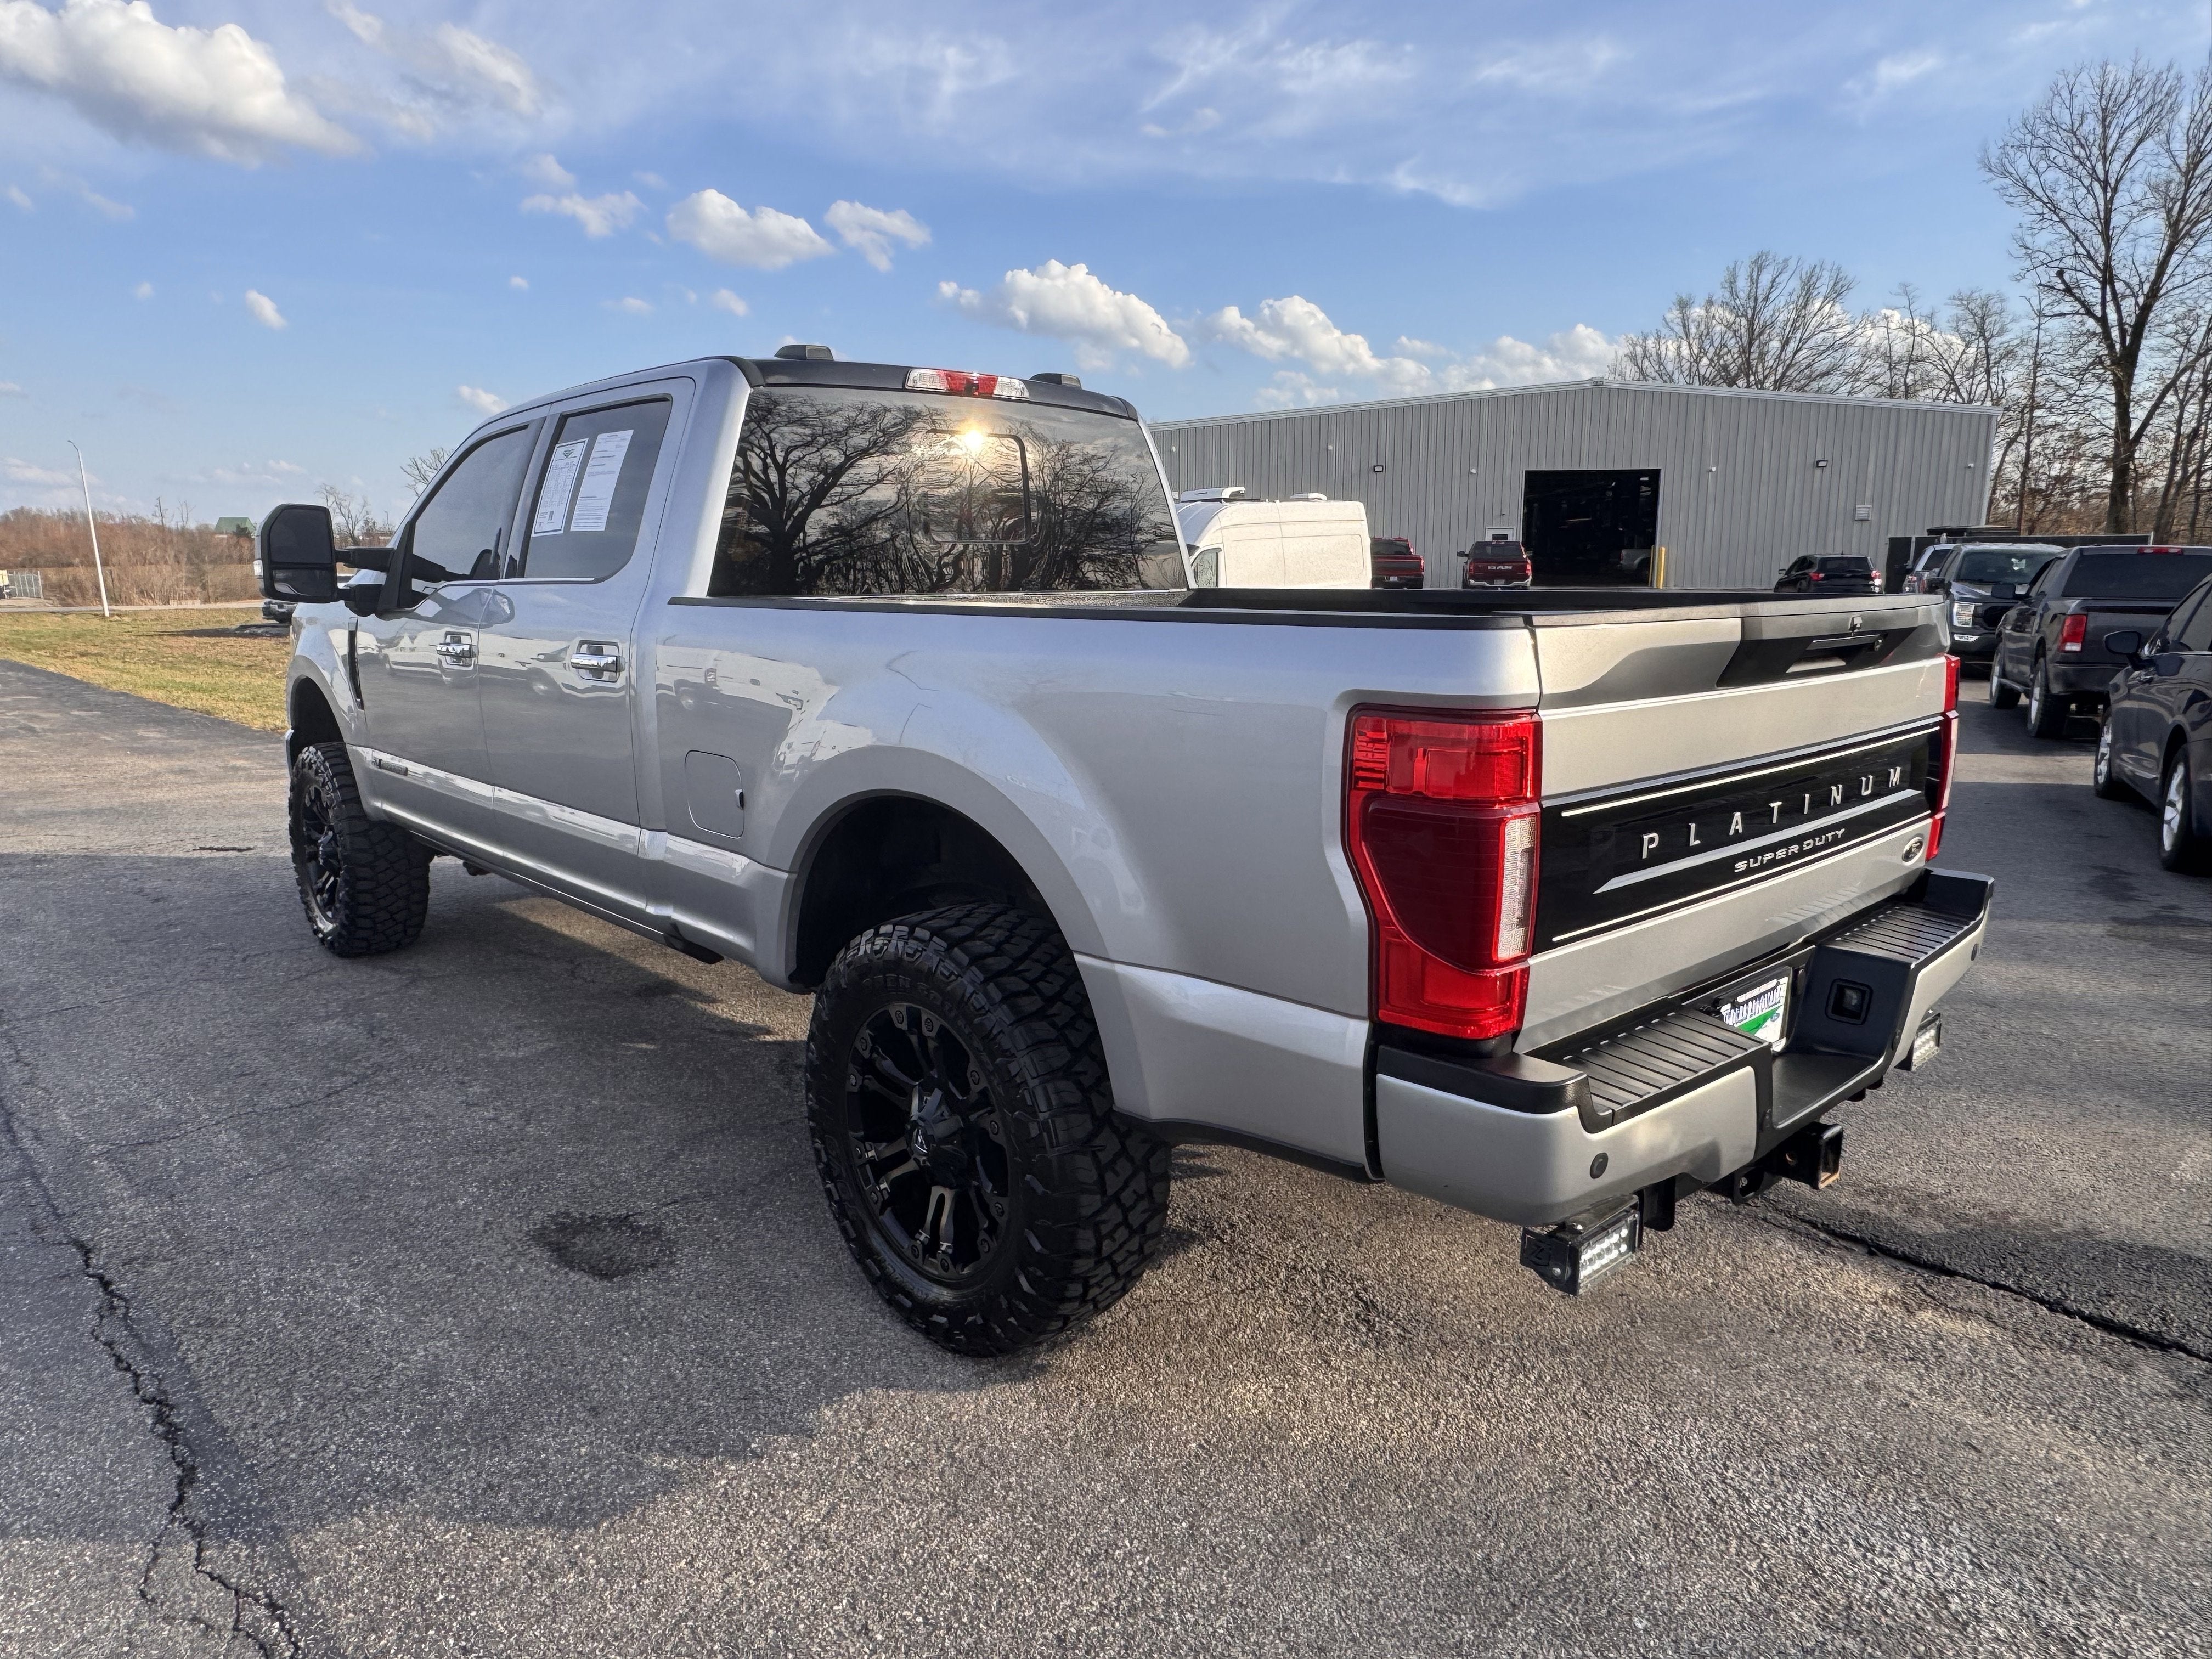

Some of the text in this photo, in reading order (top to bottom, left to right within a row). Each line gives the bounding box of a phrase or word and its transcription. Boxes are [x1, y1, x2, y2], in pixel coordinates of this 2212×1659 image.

[1641, 766, 1901, 859] PLATINUM
[1734, 828, 1846, 873] SUPER DUTY
